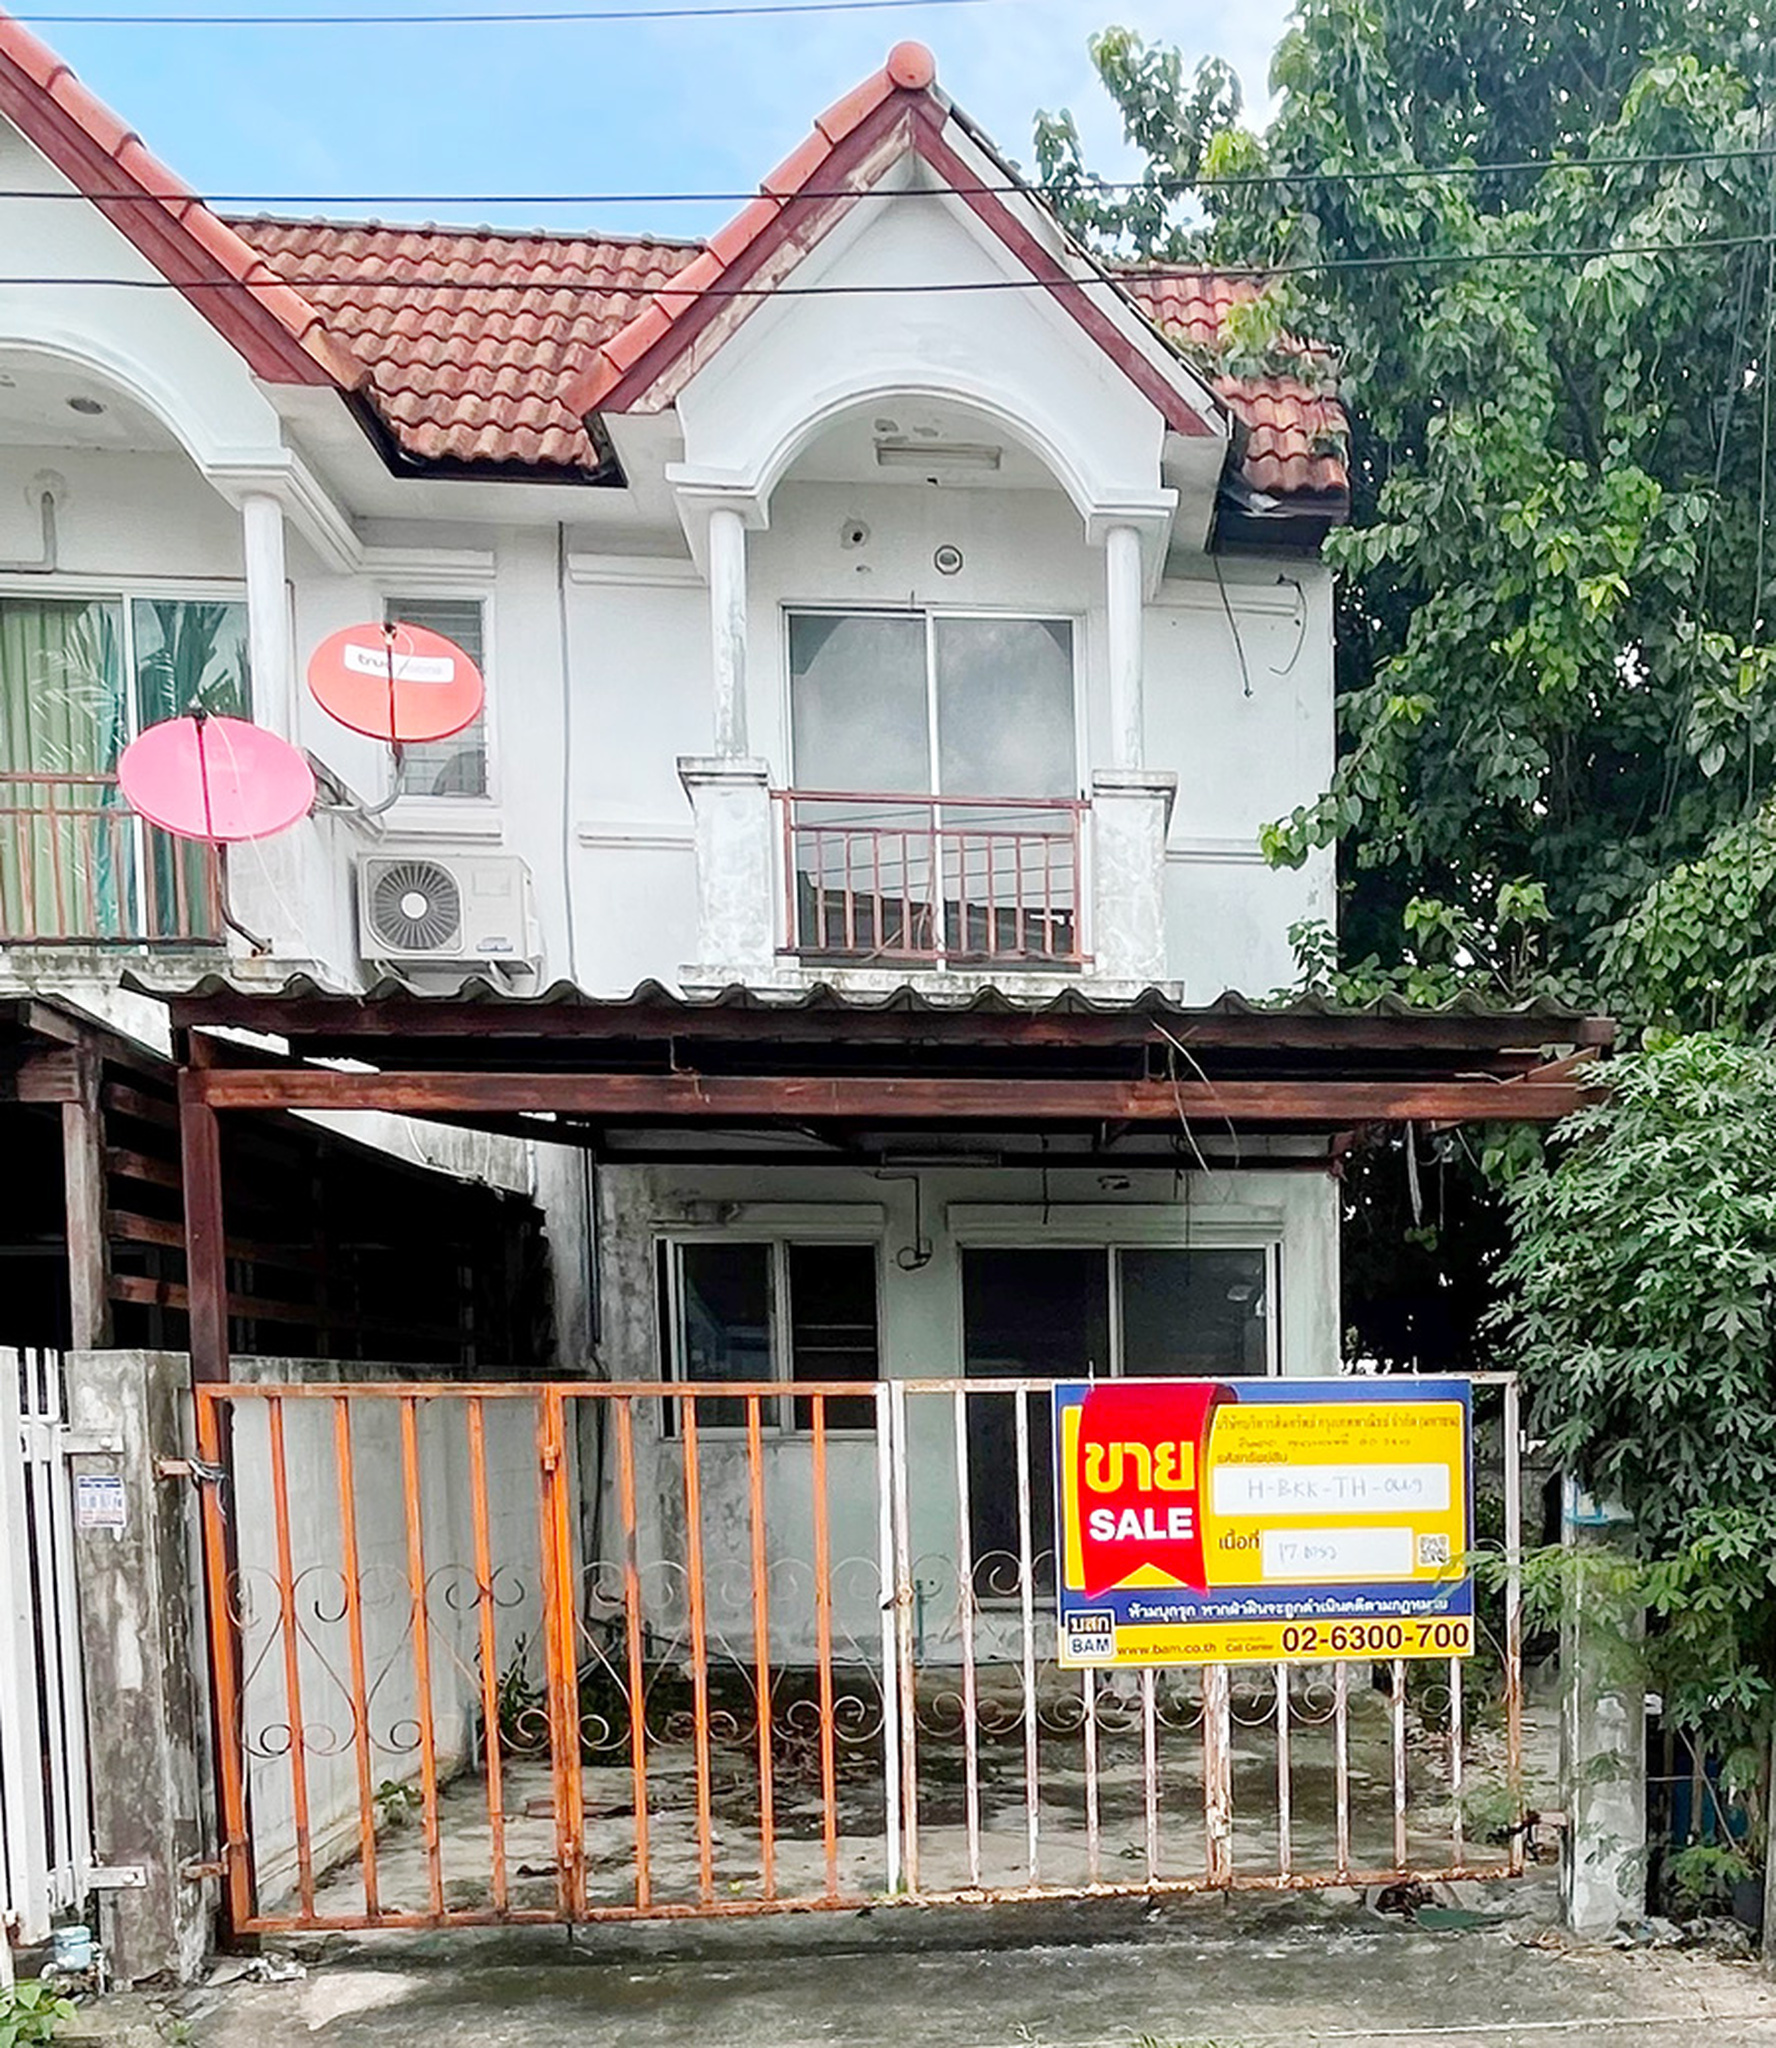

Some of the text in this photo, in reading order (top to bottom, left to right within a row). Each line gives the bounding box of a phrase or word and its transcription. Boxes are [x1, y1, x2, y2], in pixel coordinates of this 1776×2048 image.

[357, 652, 393, 669] tru
[1084, 1441, 1196, 1493] ขาย
[1088, 1506, 1195, 1542] SALE
[1218, 1528, 1261, 1551] เนื้อที่
[1128, 1602, 1196, 1622] ห้ามบุกรุก
[1070, 1614, 1110, 1633] บสก
[1071, 1637, 1110, 1654] BAM
[1281, 1622, 1470, 1652] 02-6300-700
[1116, 1643, 1217, 1656] www.bam.co.th
